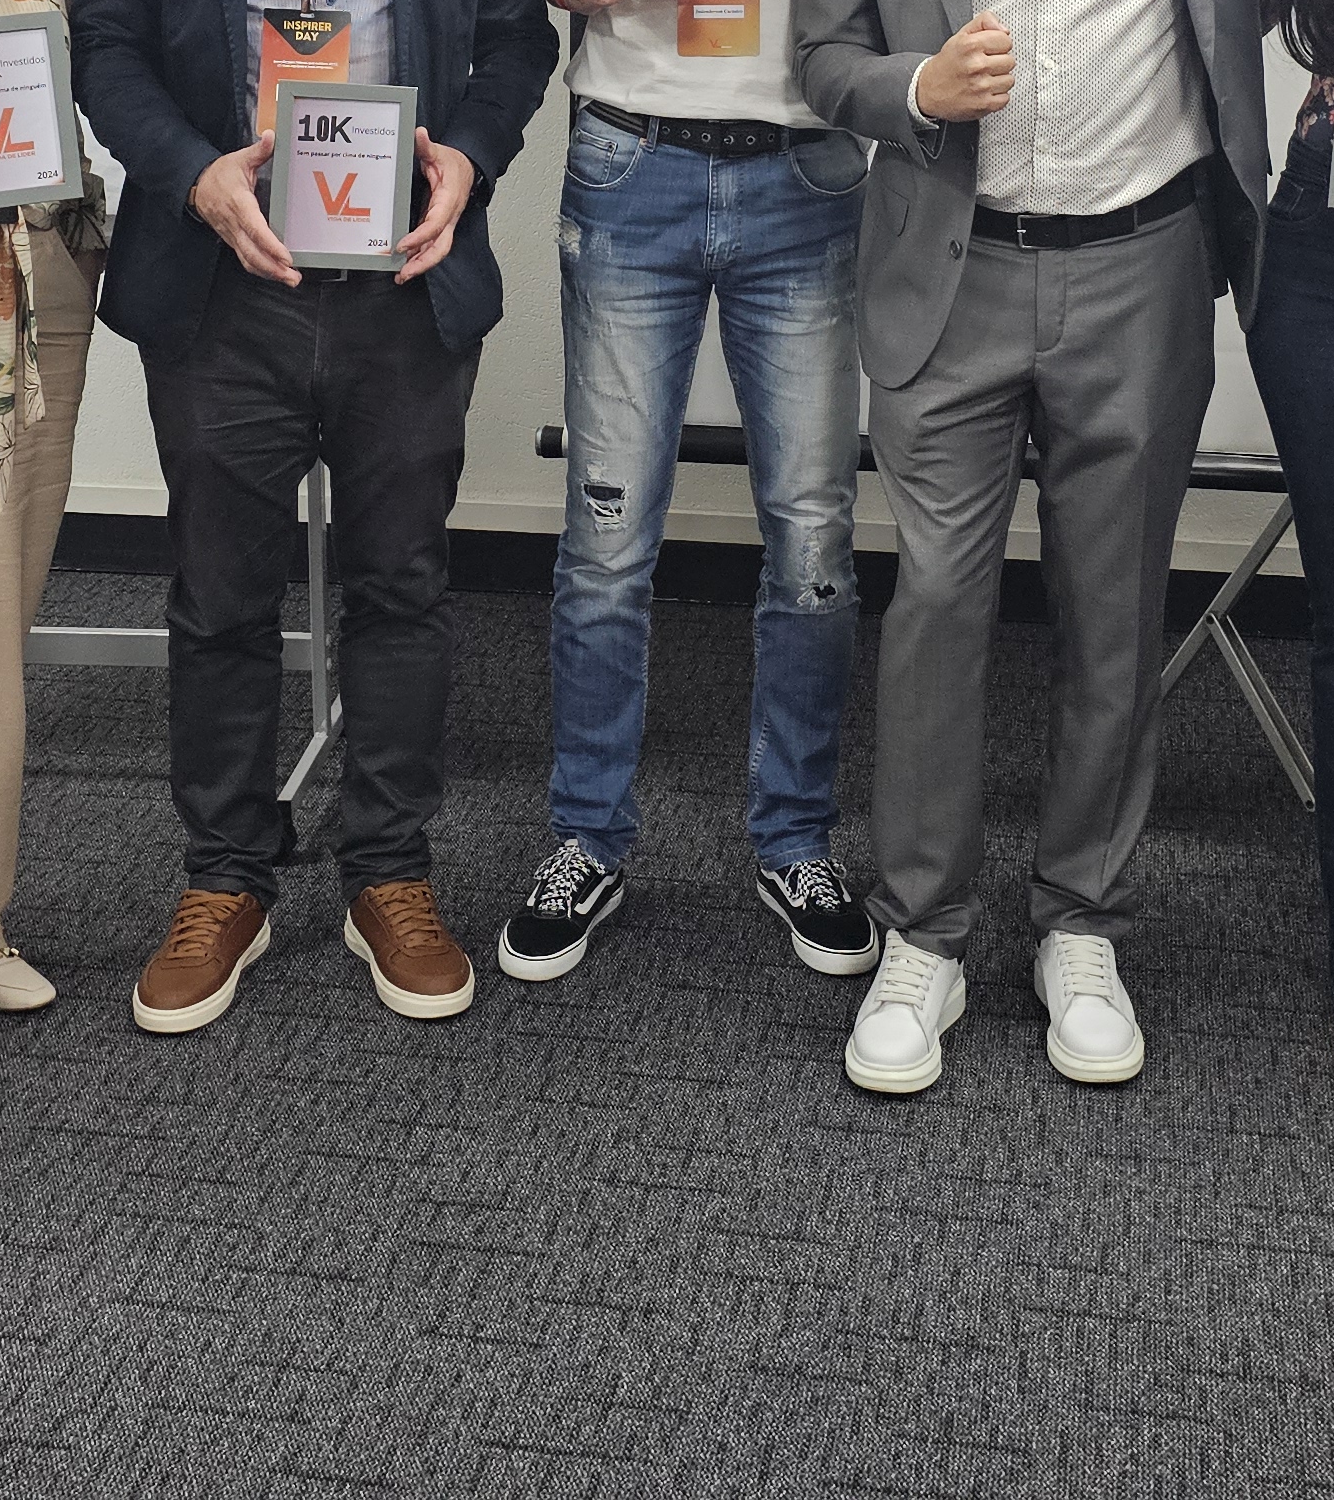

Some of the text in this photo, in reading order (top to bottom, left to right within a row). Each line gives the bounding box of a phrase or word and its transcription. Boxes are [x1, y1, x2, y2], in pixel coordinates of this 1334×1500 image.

[283, 20, 331, 31] INSPIRER
[295, 31, 319, 41] DAY
[0, 56, 46, 68] Investidos
[20, 83, 46, 92] ninguém
[297, 114, 395, 144] 10K Investidos
[38, 170, 58, 179] 2024
[312, 171, 371, 216] VL
[368, 239, 388, 247] 2024
